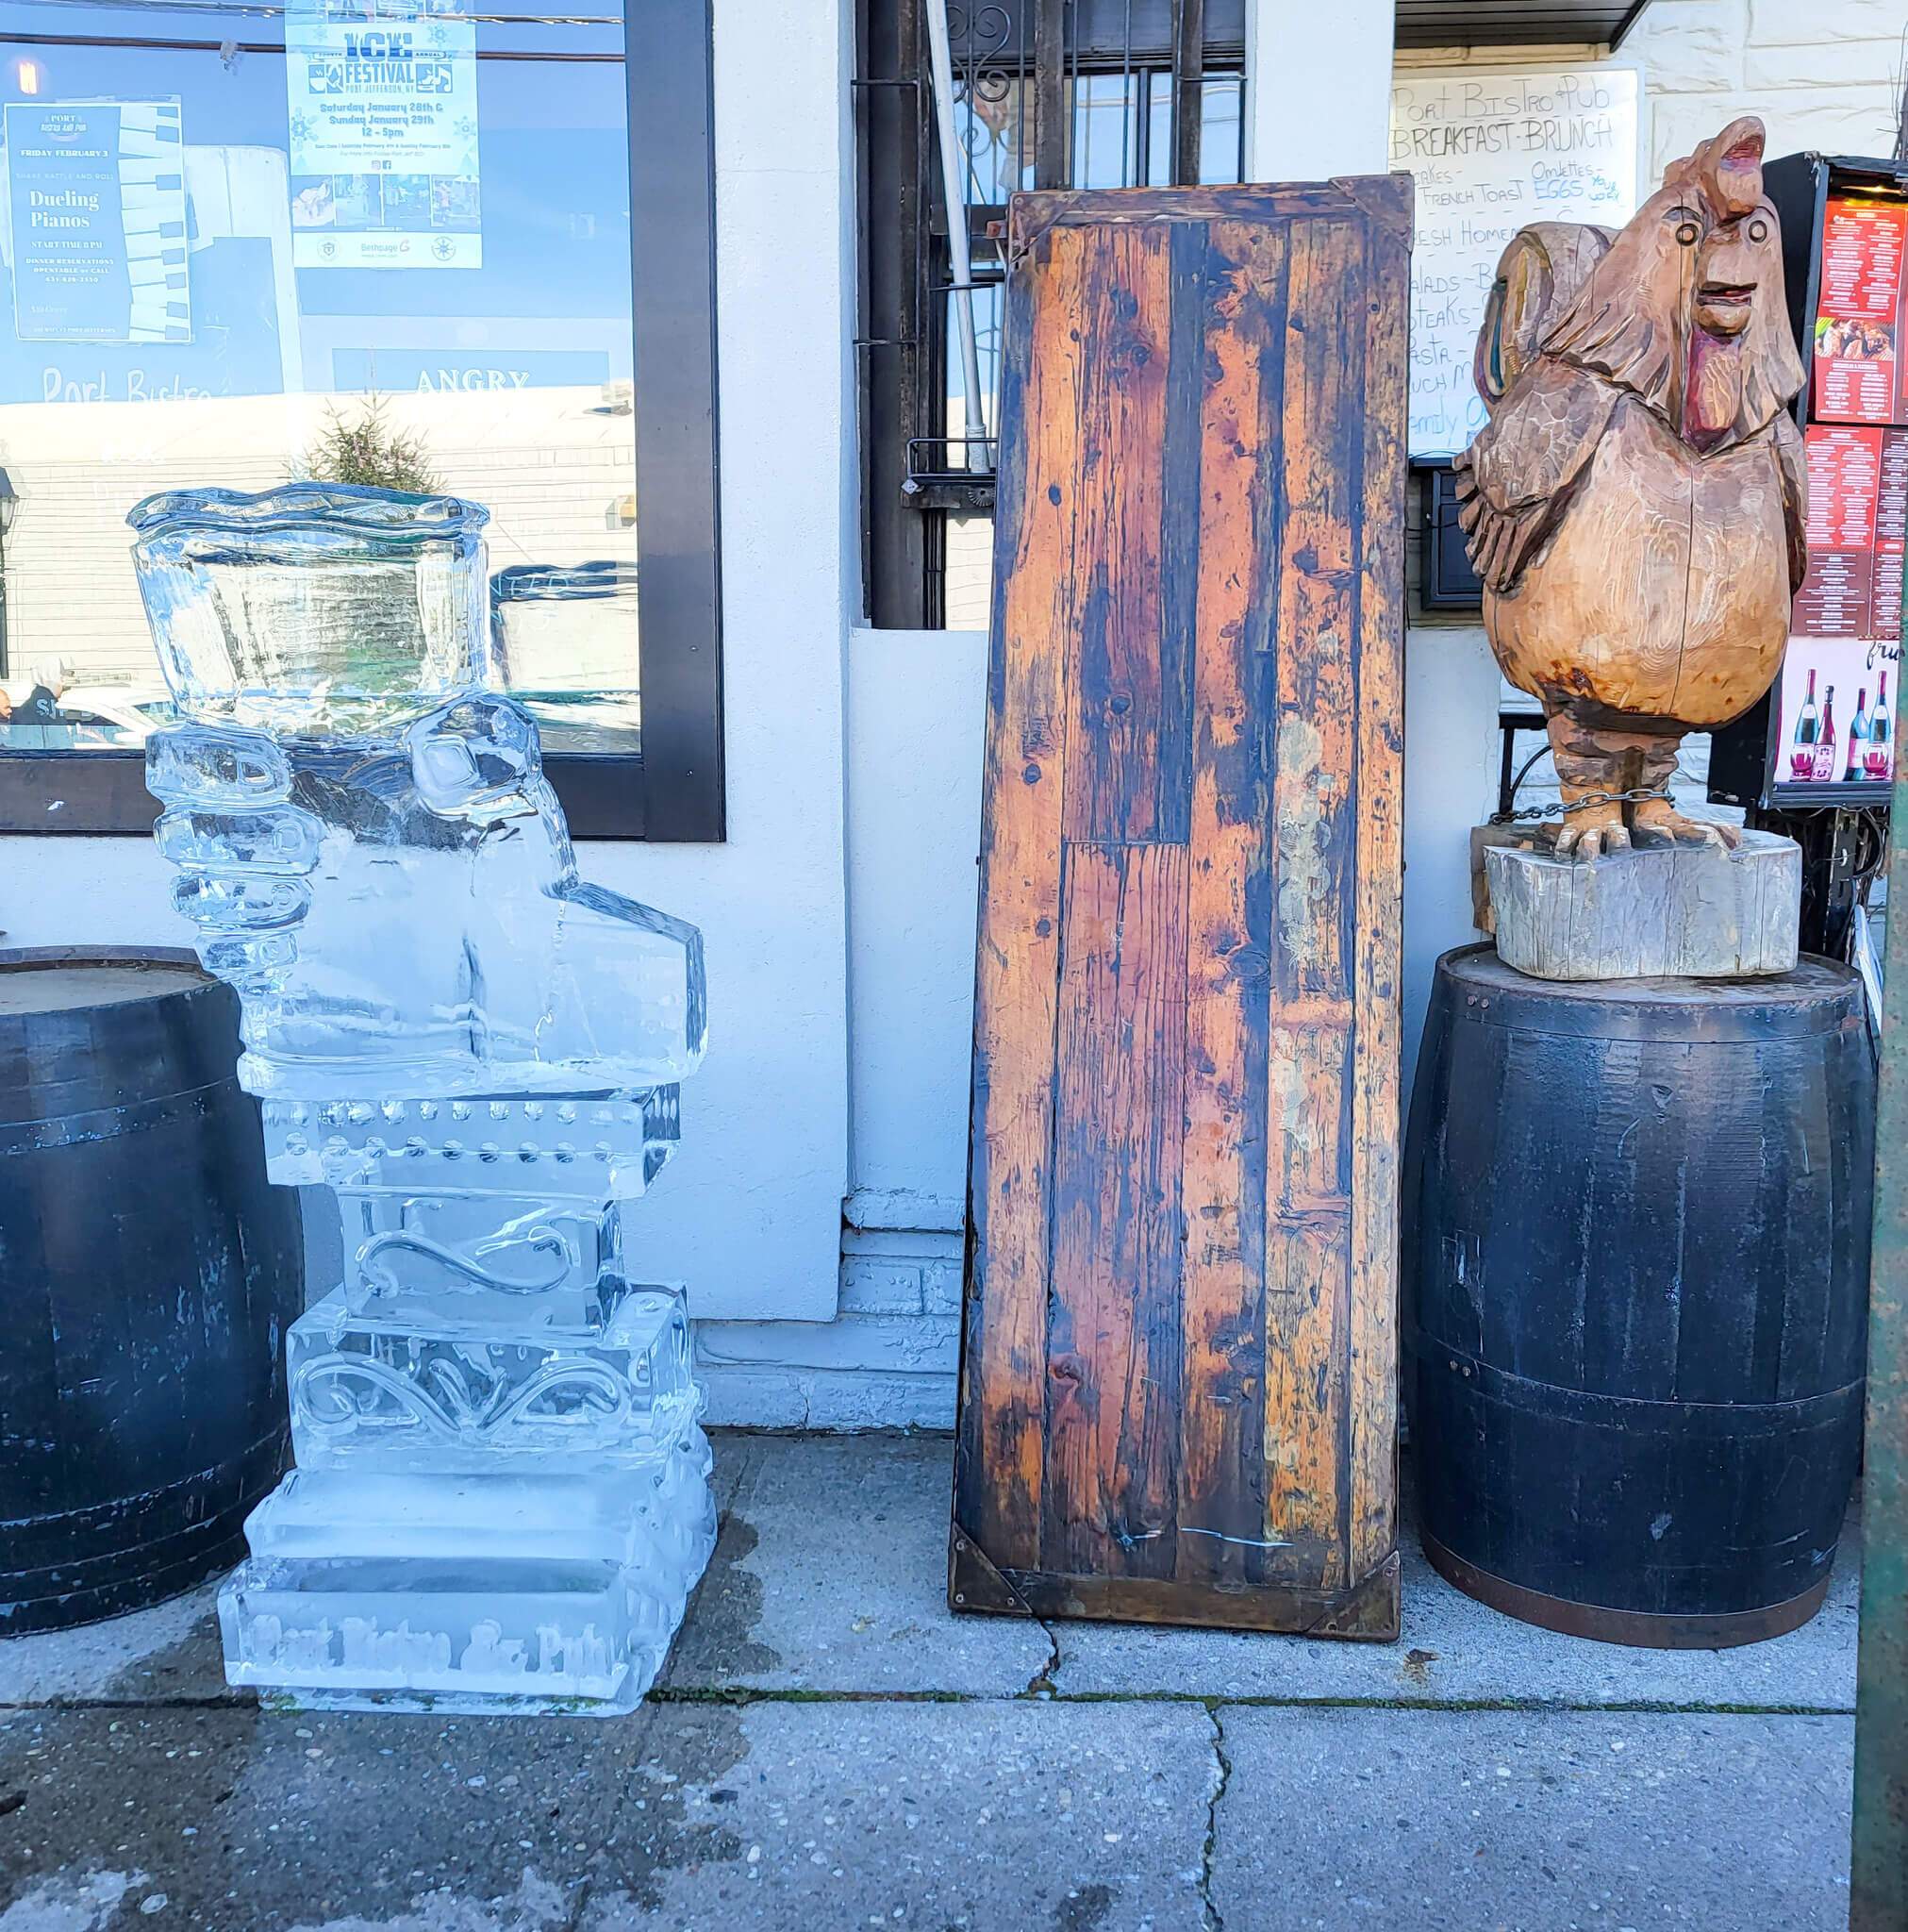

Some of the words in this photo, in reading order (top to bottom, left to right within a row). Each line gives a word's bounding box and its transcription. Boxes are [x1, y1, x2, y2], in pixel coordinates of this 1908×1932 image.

[344, 32, 412, 62] ICE
[345, 63, 415, 84] FESTIVAL
[345, 85, 362, 93] PORT
[320, 103, 364, 114] Saturday
[367, 102, 407, 114] January
[409, 102, 433, 112] 28th
[329, 115, 367, 127] Sunday
[369, 115, 408, 127] January
[411, 115, 434, 125] 29th
[362, 127, 373, 137] 12
[382, 127, 404, 139] 5pm
[1419, 186, 1474, 206] FRENCH
[1473, 180, 1525, 204] TOAST
[1534, 180, 1584, 200] EGGS
[29, 190, 99, 211] Dueling
[31, 211, 90, 227] Pianos
[31, 241, 59, 249] START
[60, 241, 82, 249] TIME
[415, 368, 530, 393] ANGRY
